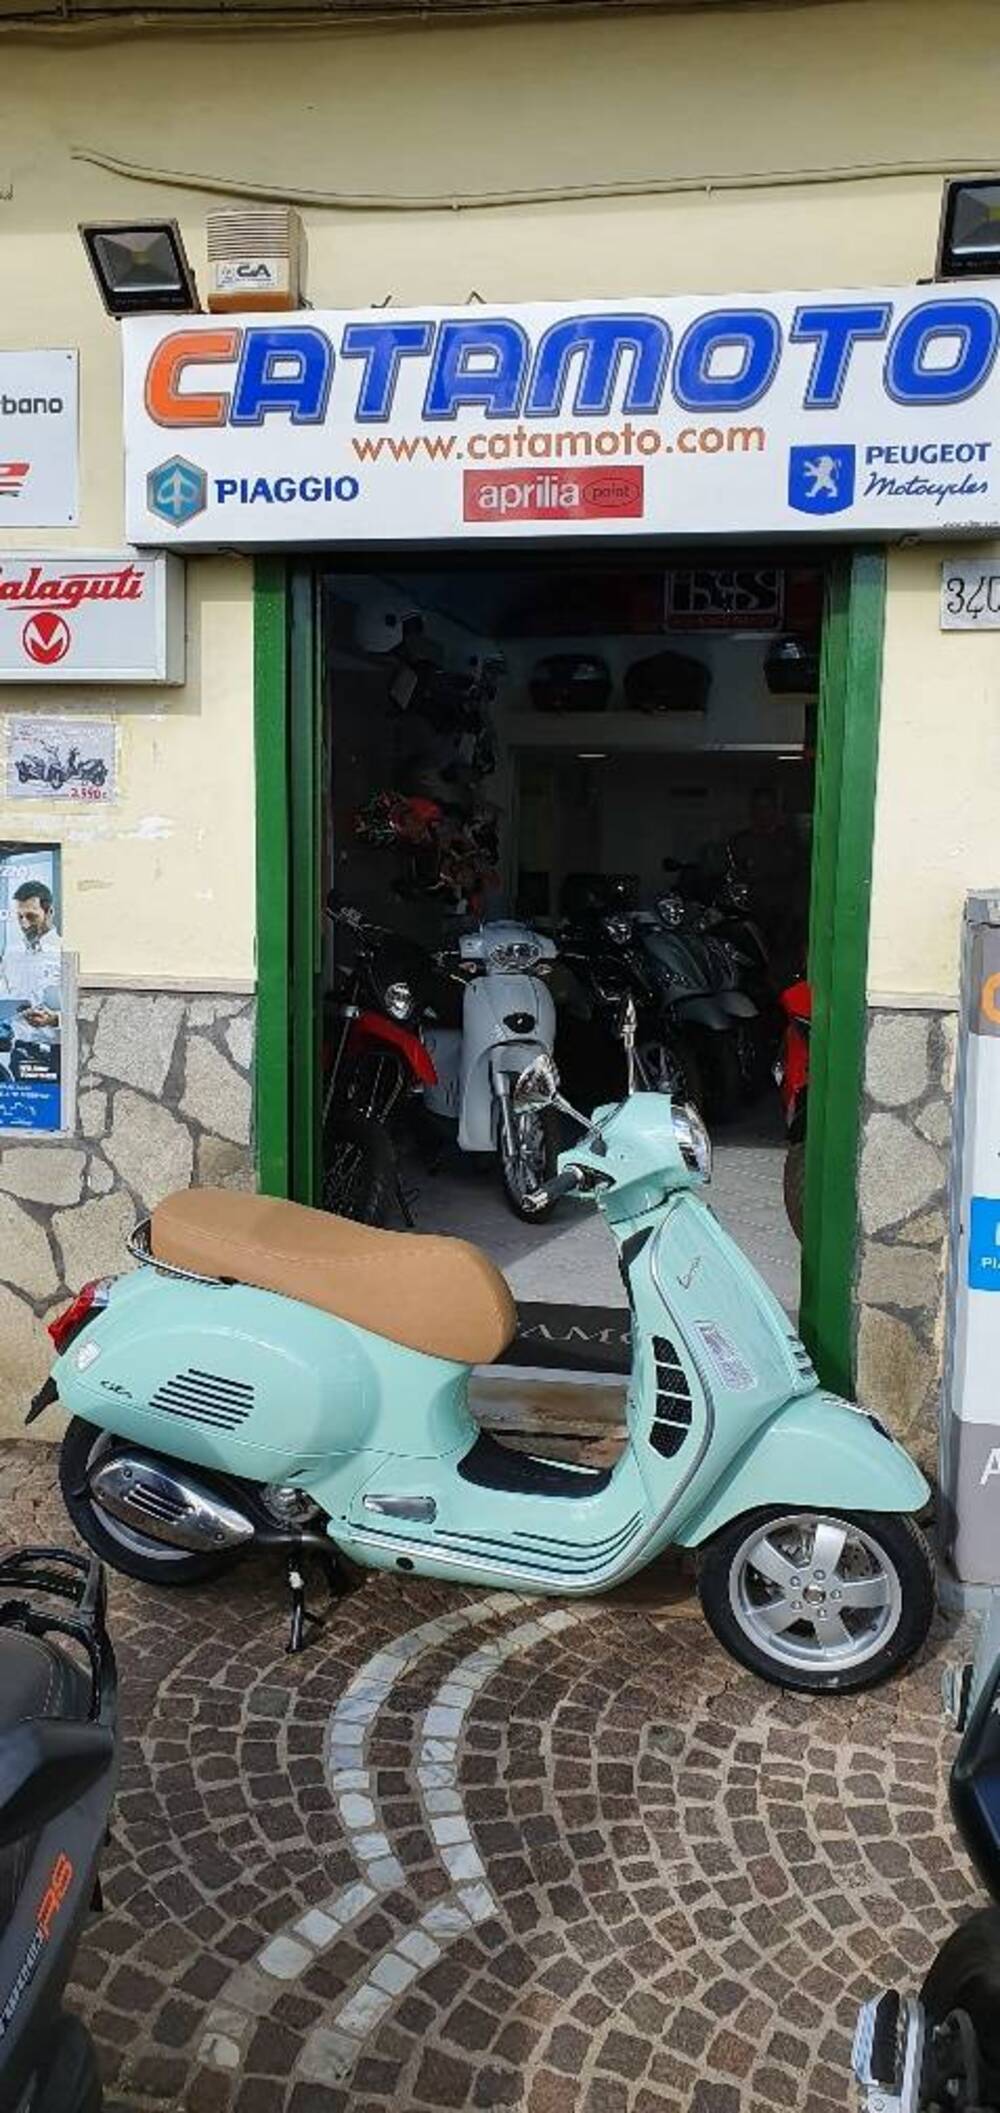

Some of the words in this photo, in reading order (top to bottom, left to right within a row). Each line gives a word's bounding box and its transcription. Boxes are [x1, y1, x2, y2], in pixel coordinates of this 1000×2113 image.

[144, 297, 1000, 427] CATAMOTO
[352, 424, 766, 463] www.catamoto.com
[865, 442, 992, 465] PEUGEOT
[215, 475, 360, 504] PIAGGIO
[479, 475, 580, 514] aprilia
[592, 482, 631, 501] point
[0, 563, 145, 610] alaguti
